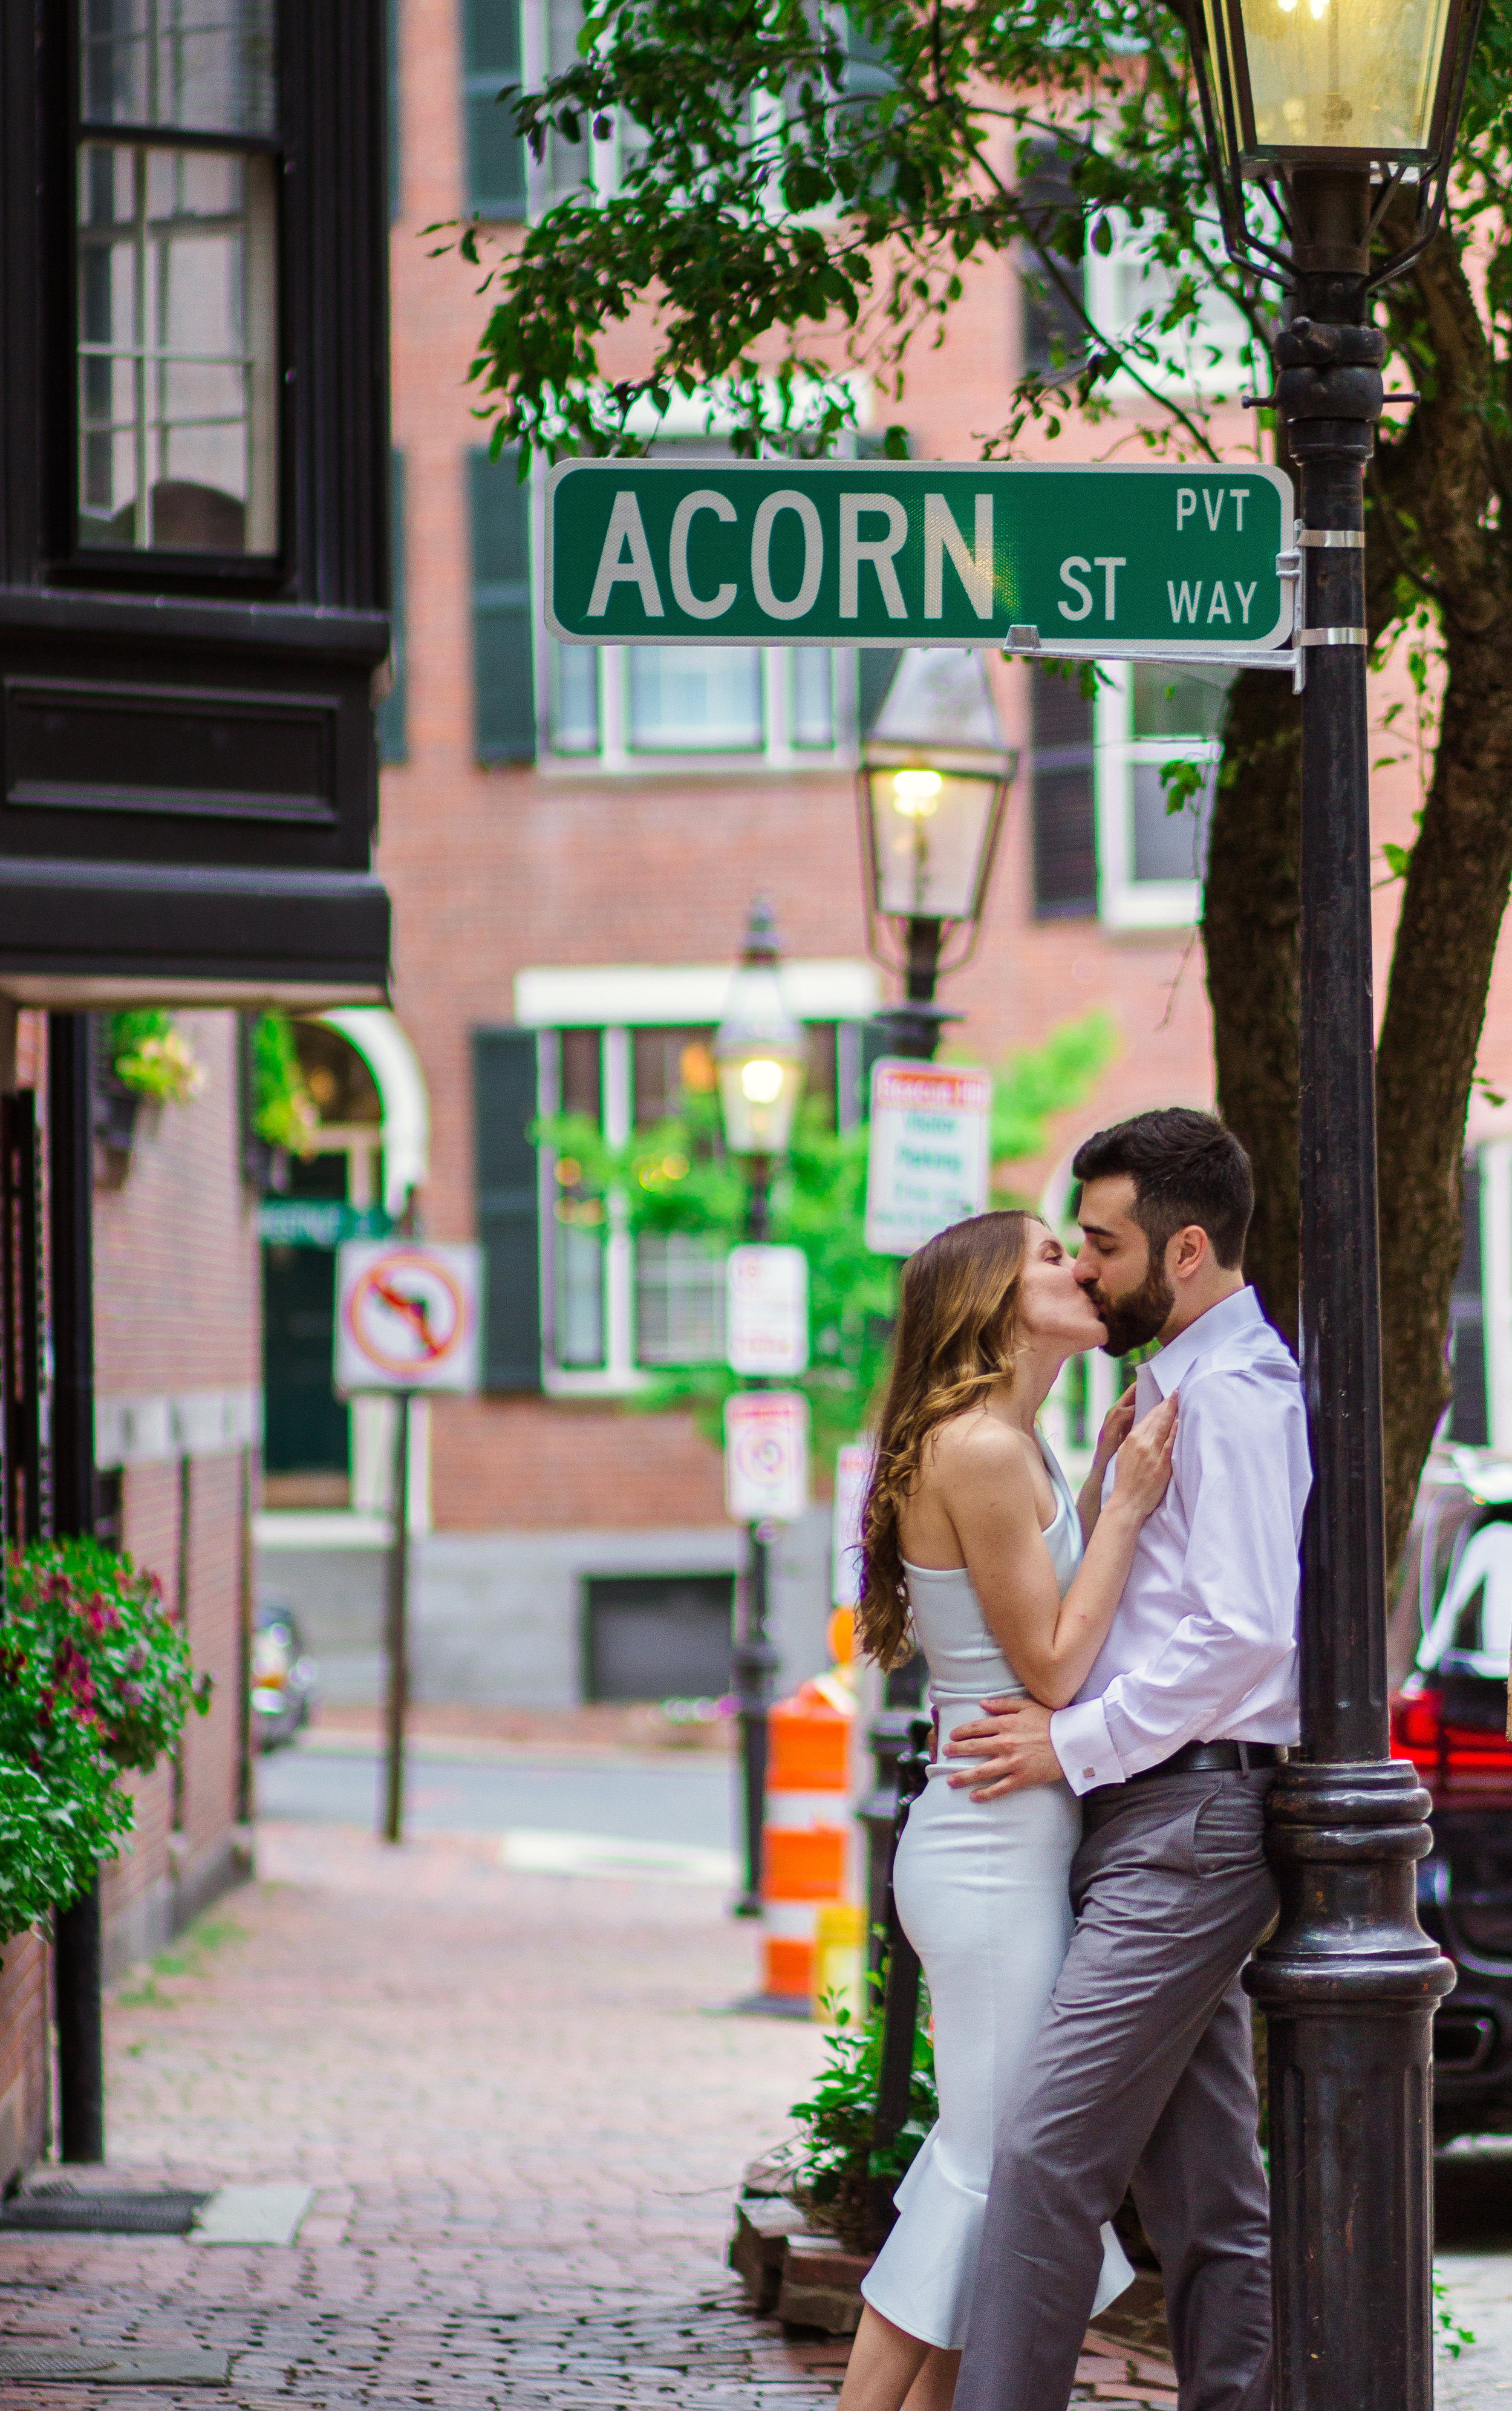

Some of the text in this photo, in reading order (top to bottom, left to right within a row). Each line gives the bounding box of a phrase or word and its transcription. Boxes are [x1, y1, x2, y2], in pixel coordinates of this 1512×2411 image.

[1177, 488, 1250, 531] PVT
[587, 489, 1126, 621] ACORN ST
[1167, 581, 1257, 624] WAY
